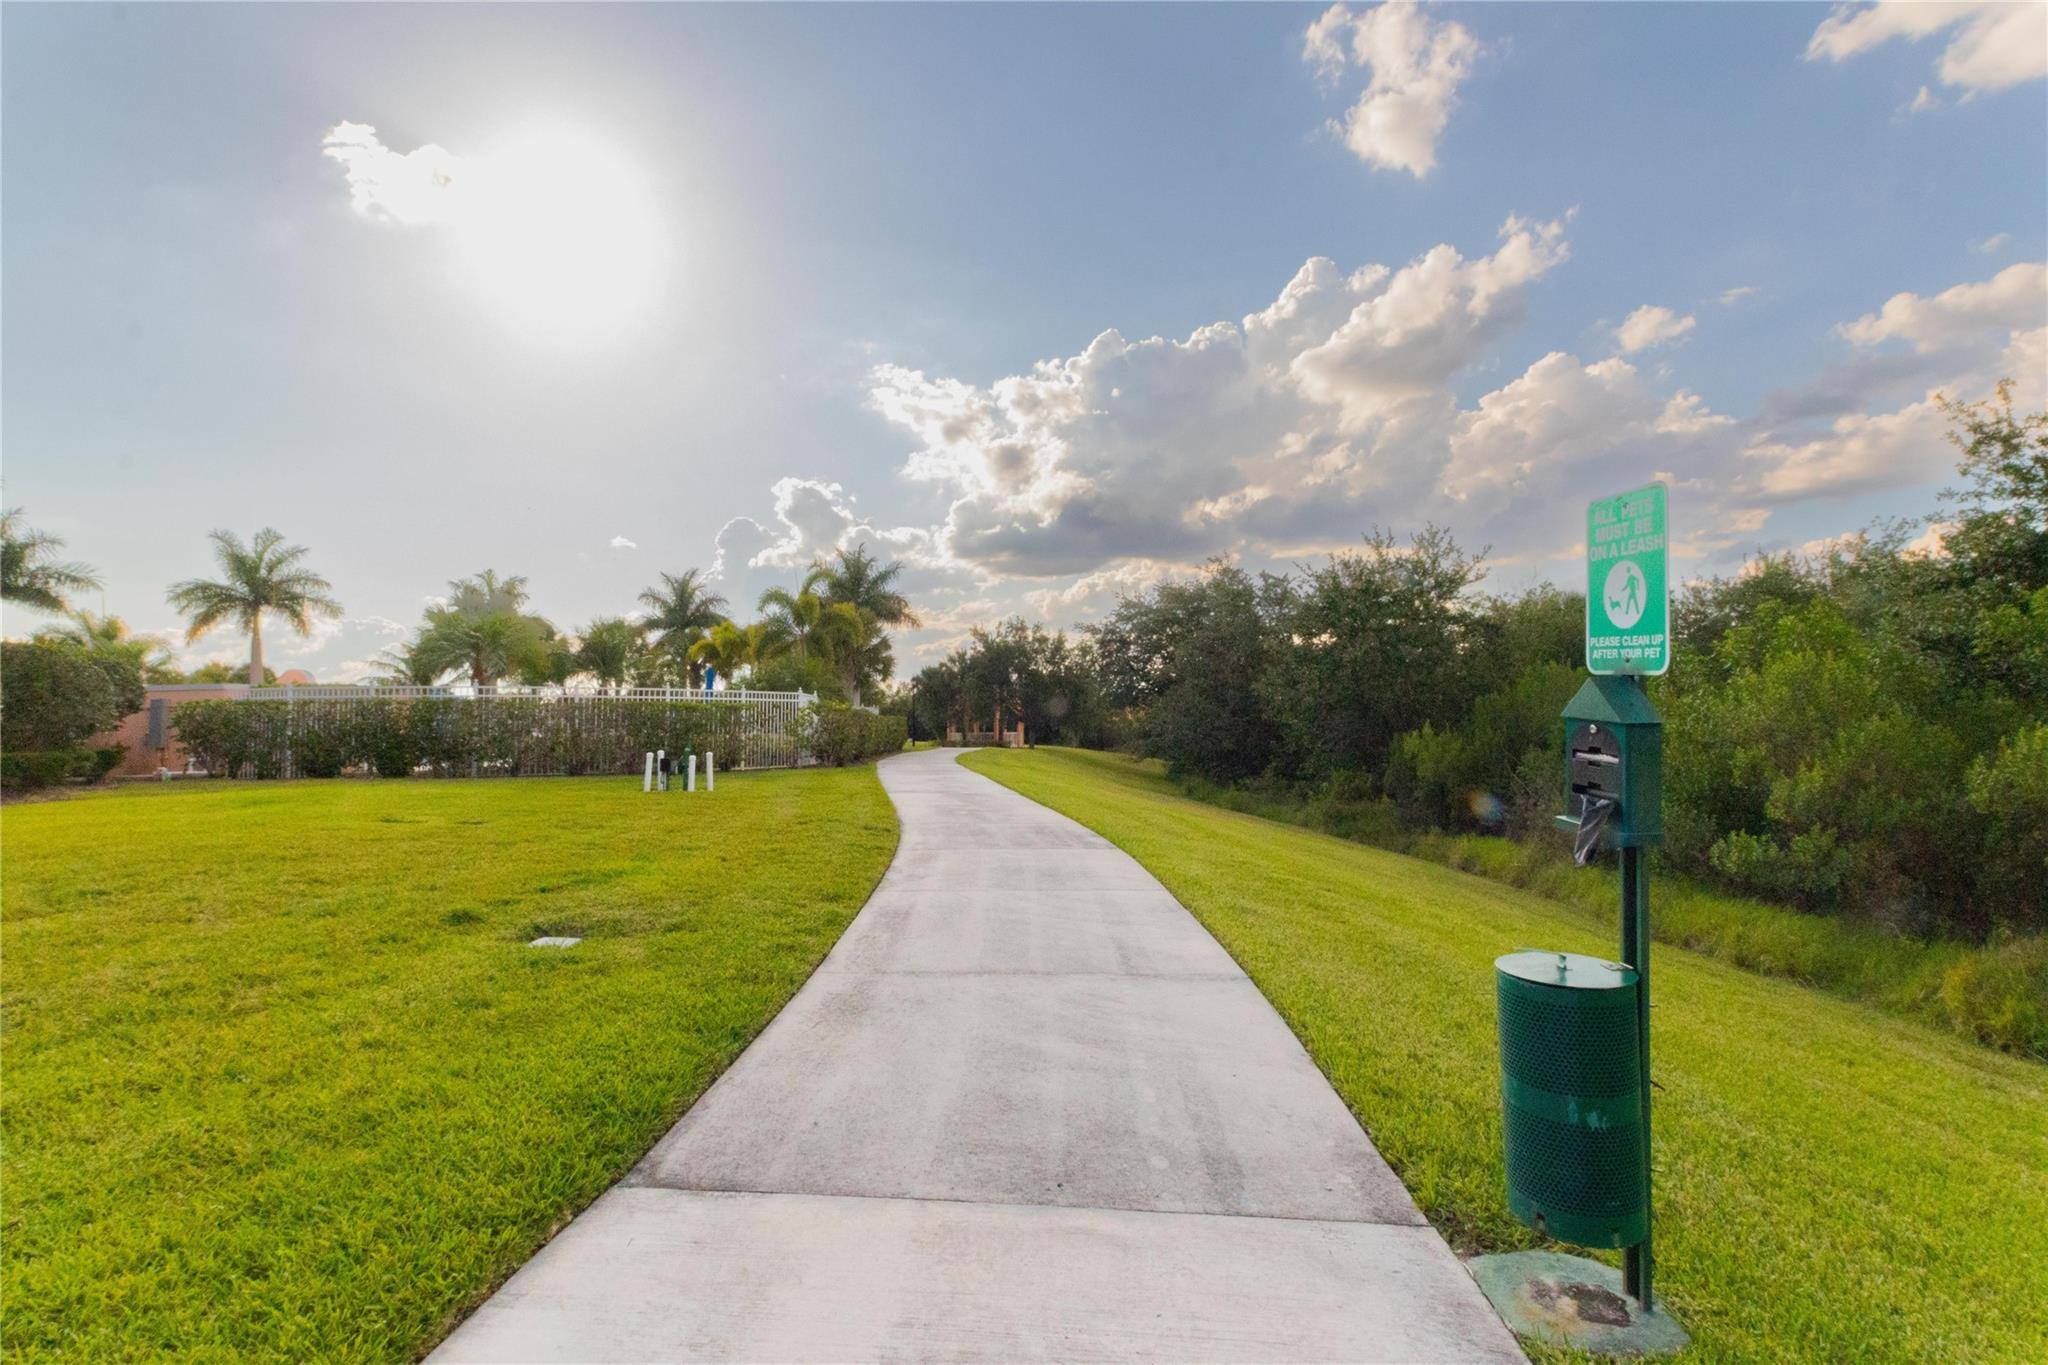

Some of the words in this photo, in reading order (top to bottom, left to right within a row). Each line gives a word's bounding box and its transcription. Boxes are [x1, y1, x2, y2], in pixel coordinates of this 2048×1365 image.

[1596, 522, 1630, 542] MUST
[1635, 517, 1653, 534] BE
[1590, 545, 1607, 561] ON
[1609, 543, 1618, 558] A
[1621, 534, 1664, 556] LEASH
[1590, 636, 1621, 647] PLEASE
[1622, 635, 1650, 646] CLEAN
[1651, 634, 1664, 645] UP
[1592, 648, 1618, 659] AFTER
[1620, 648, 1642, 658] YOUR
[1644, 647, 1661, 658] PET
